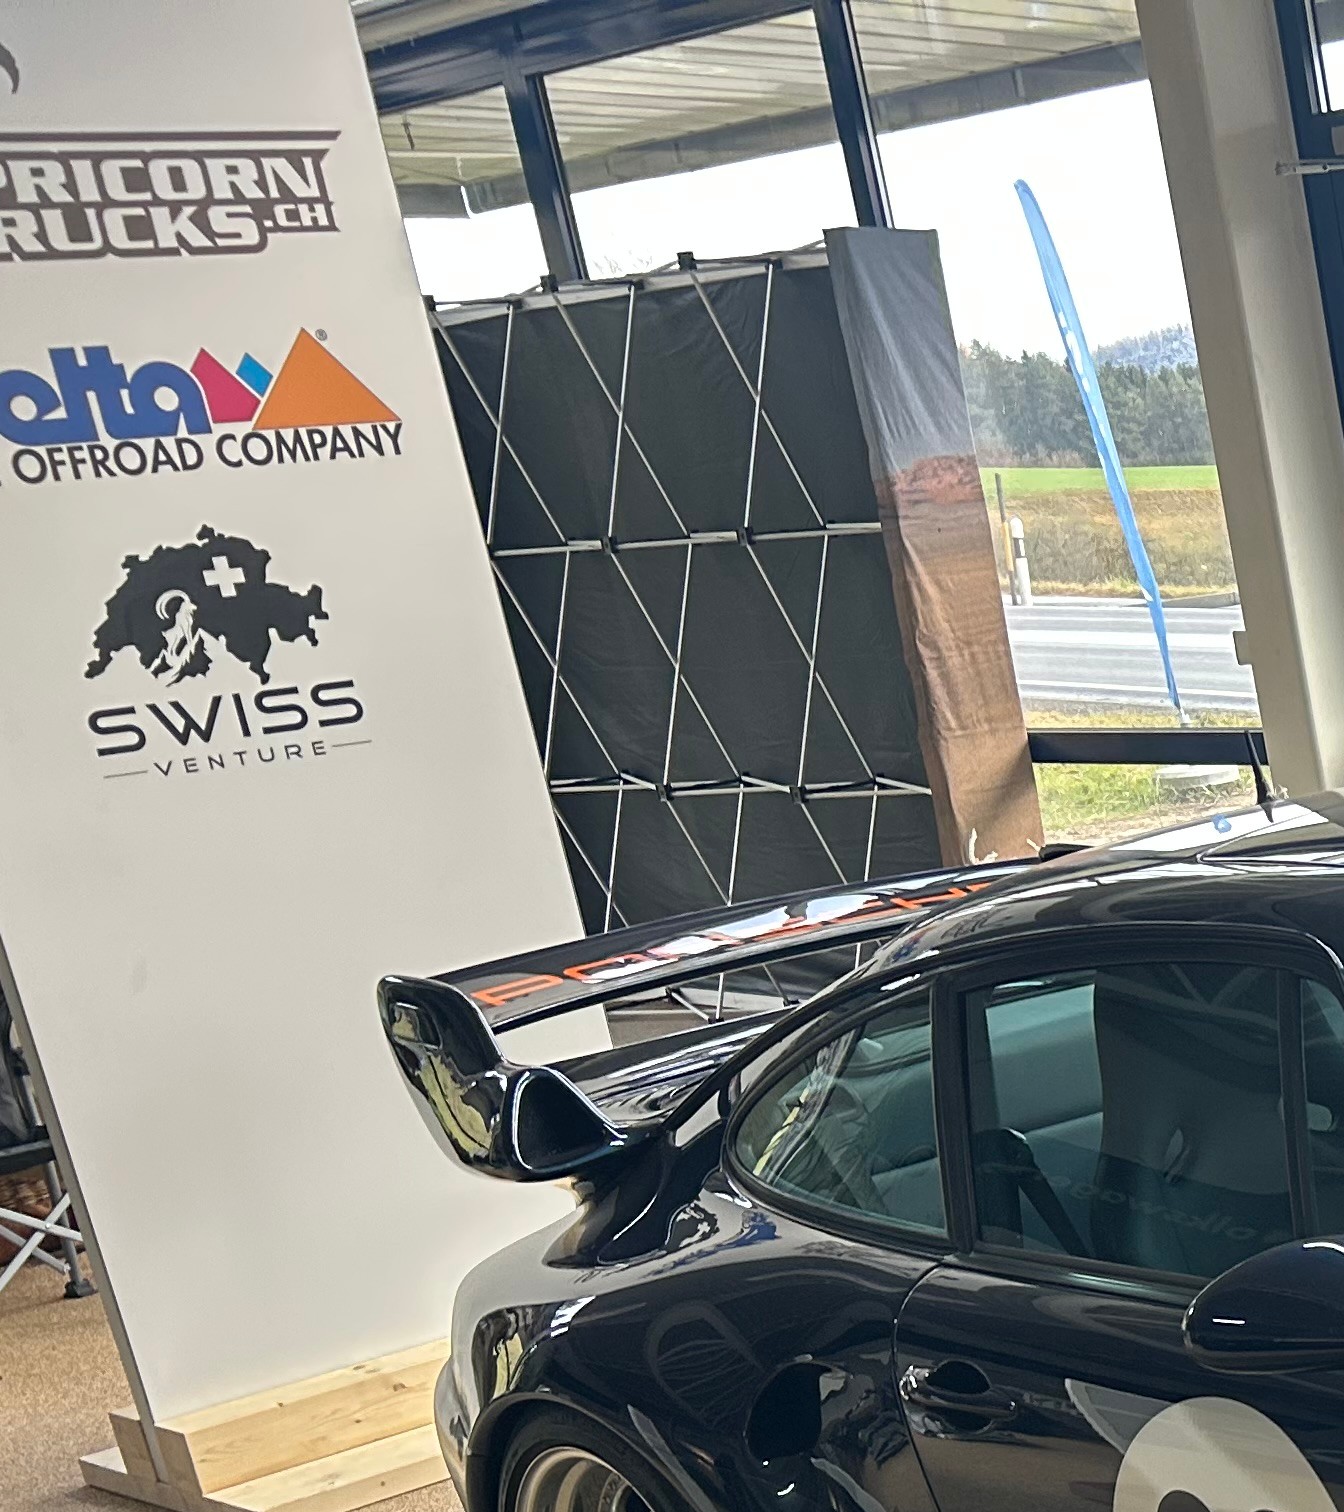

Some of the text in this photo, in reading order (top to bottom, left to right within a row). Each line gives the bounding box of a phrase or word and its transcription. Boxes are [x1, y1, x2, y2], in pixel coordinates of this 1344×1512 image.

[0, 156, 320, 205] RICORN
[11, 421, 404, 485] OFFROAD COMPANY
[87, 678, 365, 758] SWISS
[153, 739, 329, 778] VENTURE
